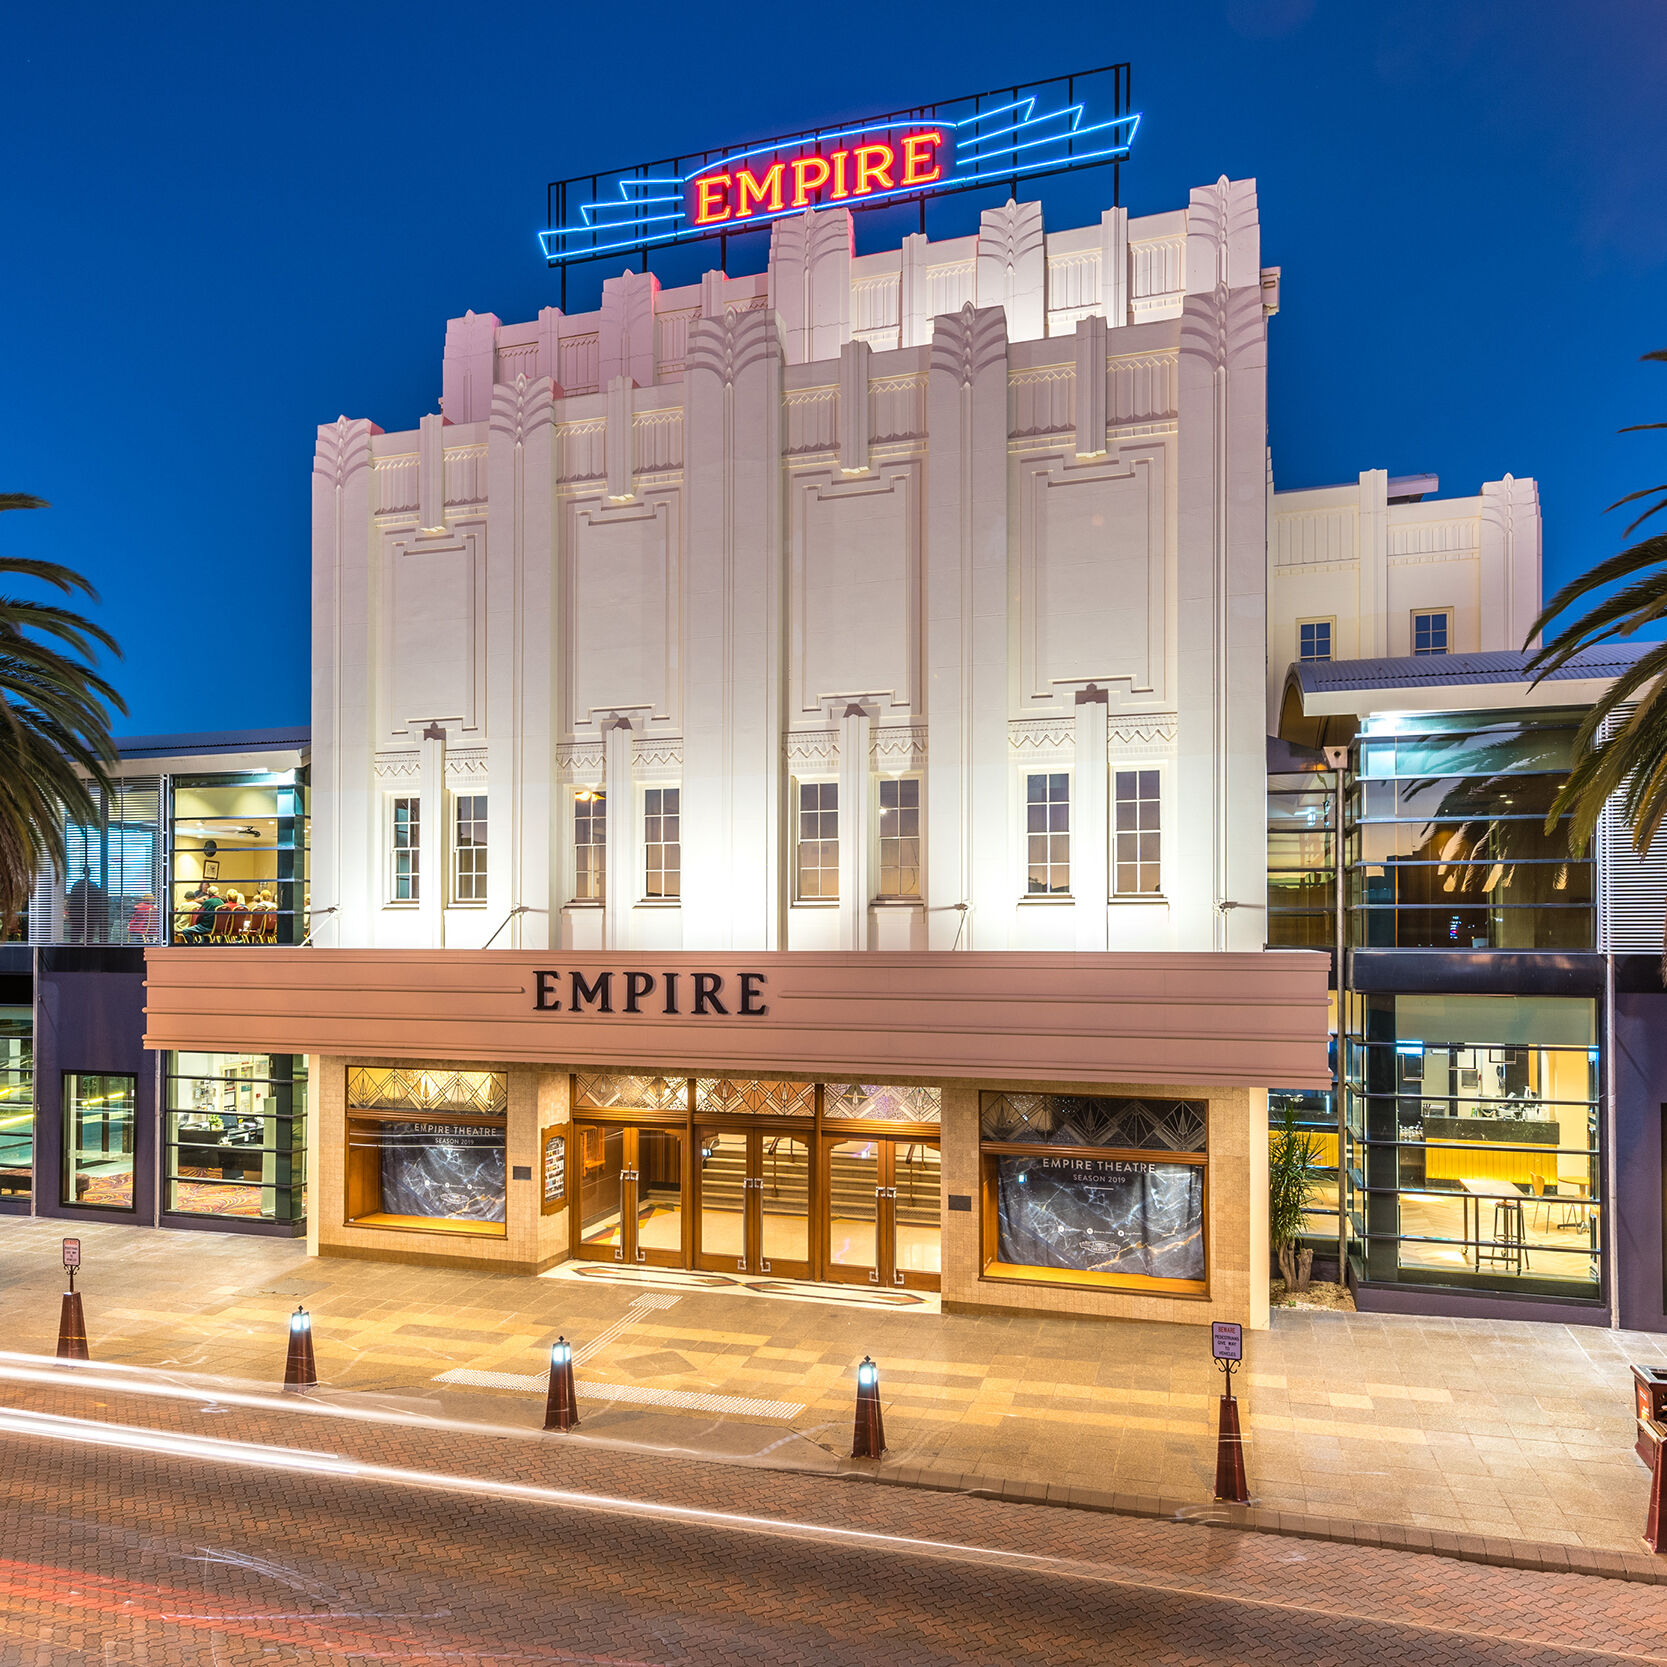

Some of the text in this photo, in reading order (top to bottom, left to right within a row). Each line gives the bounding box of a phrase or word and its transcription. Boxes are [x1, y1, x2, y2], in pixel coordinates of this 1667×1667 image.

[695, 132, 942, 225] EMPIRE
[532, 970, 768, 1016] EMPIRE
[414, 1123, 497, 1136] EMPIRE THEATRE
[435, 1137, 460, 1145] SEASON
[1042, 1158, 1156, 1173] EMPIRE THEATRE
[1073, 1174, 1126, 1184] SEASON 2019
